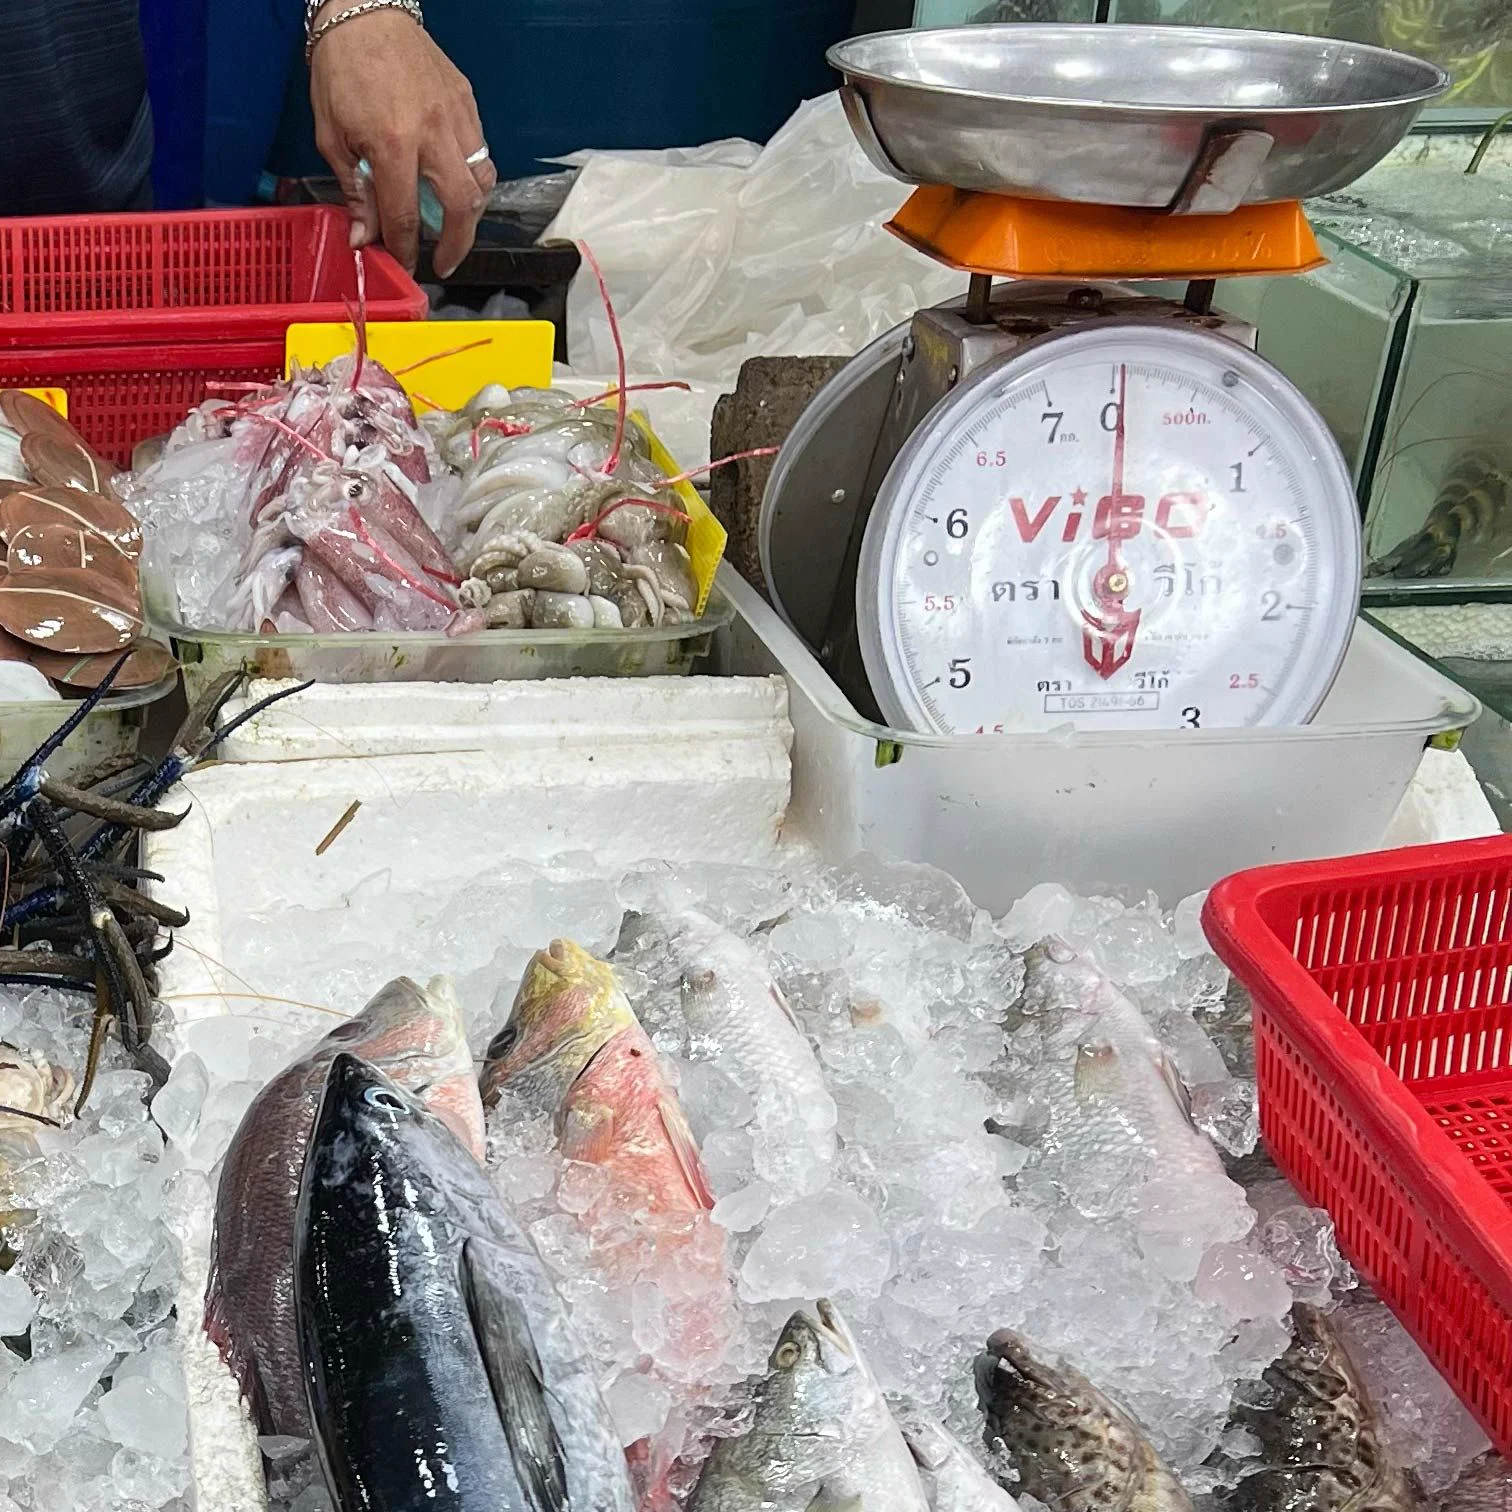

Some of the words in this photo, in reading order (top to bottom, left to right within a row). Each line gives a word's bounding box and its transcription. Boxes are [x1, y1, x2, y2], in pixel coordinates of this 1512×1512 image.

[976, 451, 1006, 468] 6.5
[1229, 462, 1247, 493] 1
[945, 508, 969, 539] 6
[991, 578, 1061, 602] ตรา
[924, 595, 955, 612] 5.5
[1260, 591, 1283, 622] 2
[948, 657, 972, 690] 5
[1229, 674, 1259, 689] 2.5
[1036, 679, 1072, 693] ตรา
